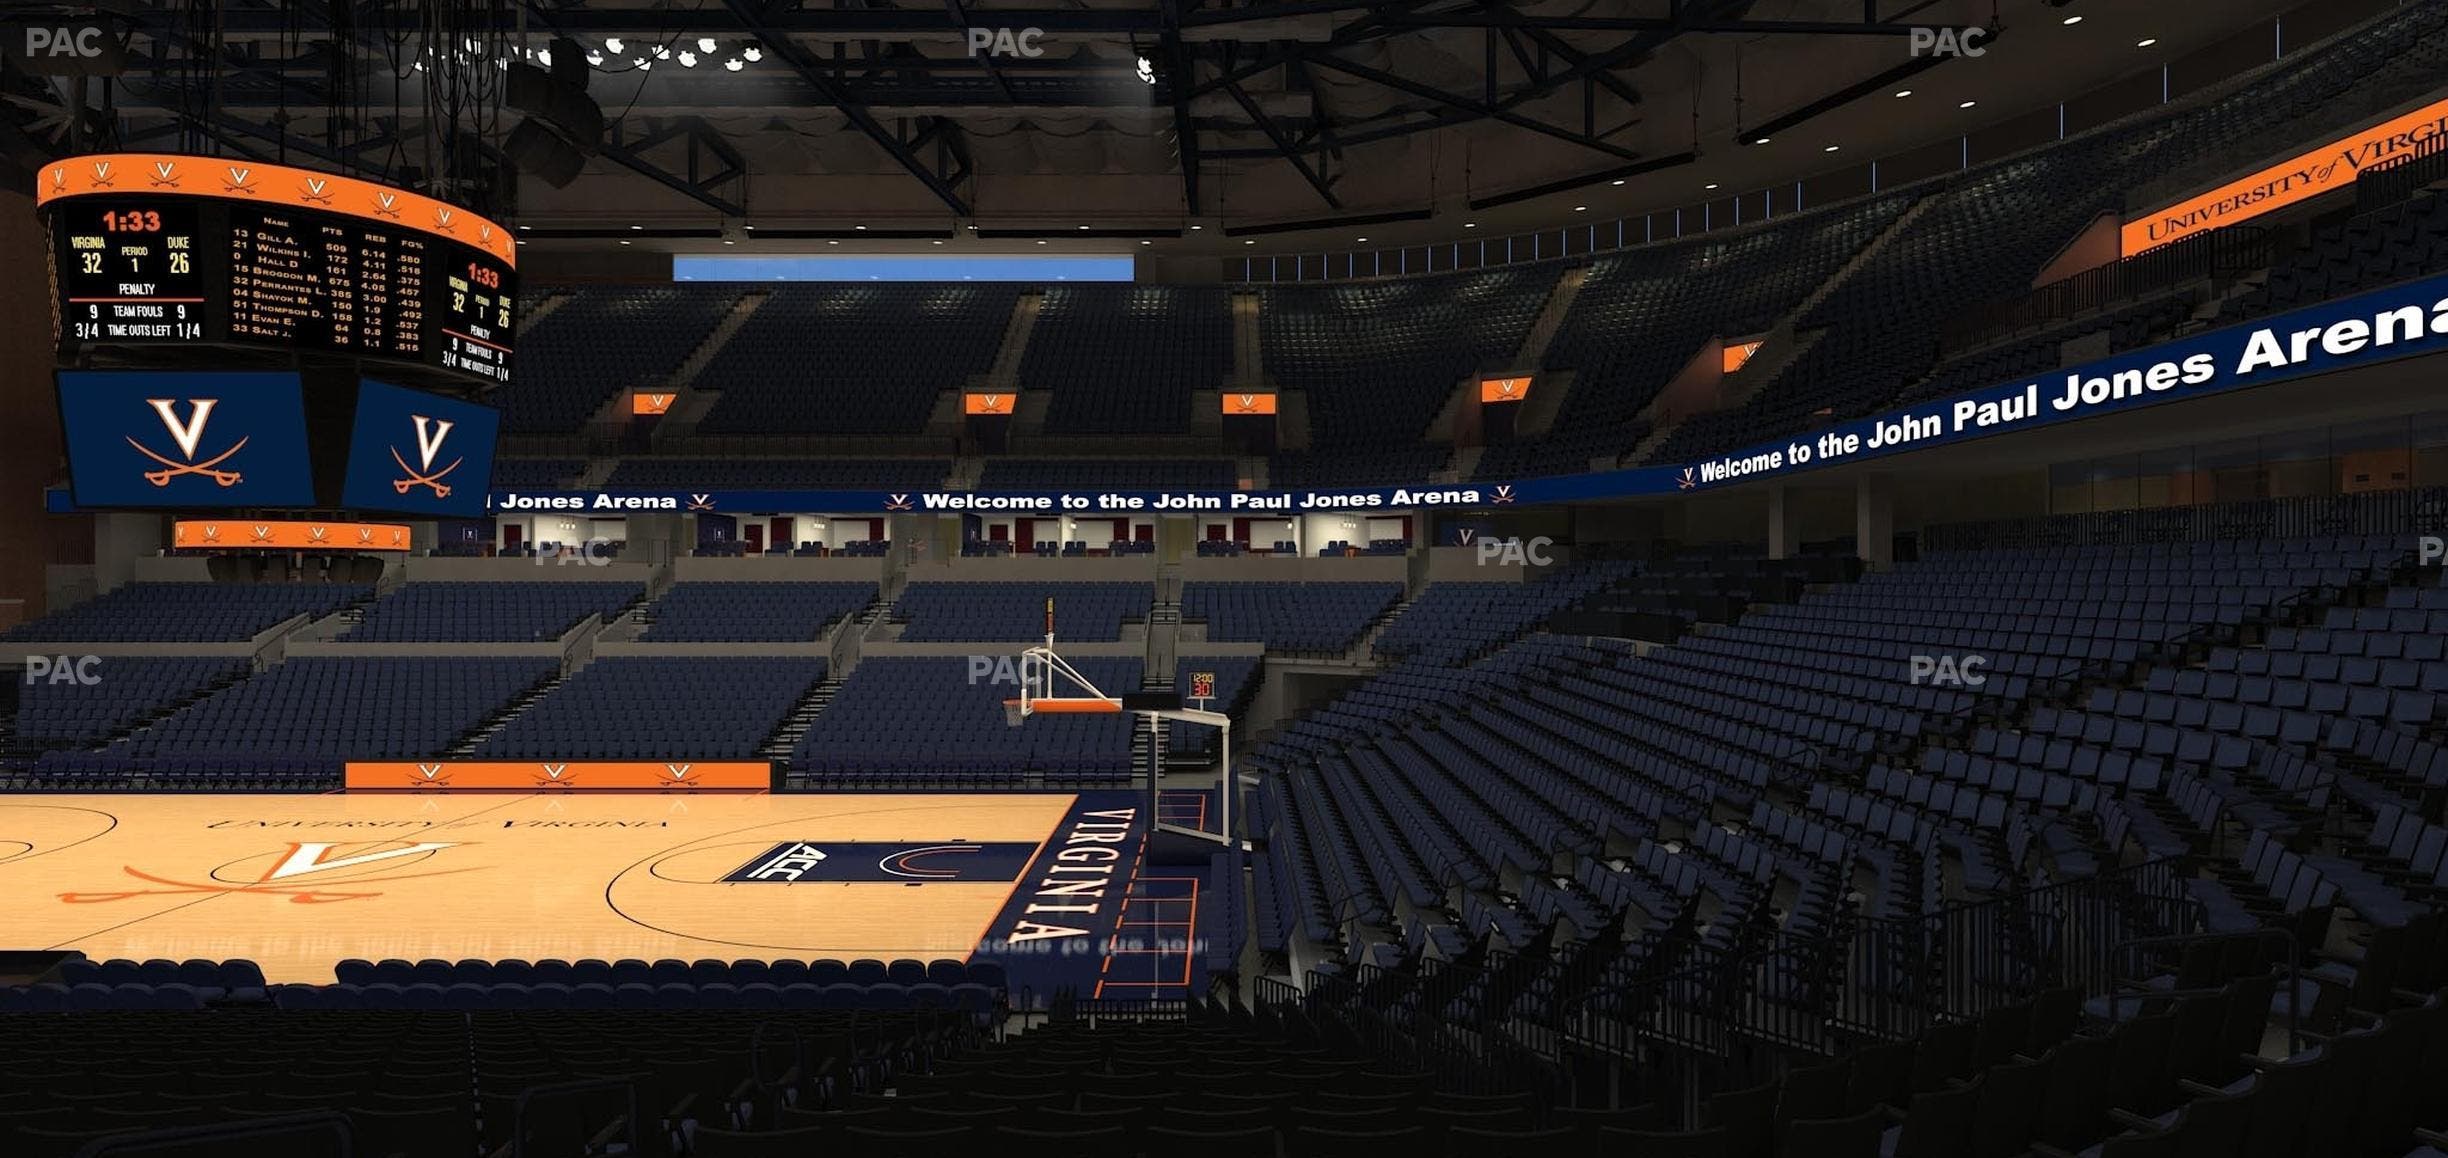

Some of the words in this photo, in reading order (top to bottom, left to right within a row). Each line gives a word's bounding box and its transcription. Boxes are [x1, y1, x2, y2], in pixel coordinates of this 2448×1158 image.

[2148, 166, 2319, 242] UNIVERSITY
[2317, 157, 2339, 183] of
[103, 211, 161, 232] 1:33
[71, 236, 106, 249] VIRGINIA
[167, 236, 190, 249] DUKE
[234, 229, 248, 237] 13
[285, 236, 299, 246] A.
[326, 243, 347, 253] 509
[362, 249, 386, 259] 6.14
[322, 227, 343, 236] PTS
[365, 234, 386, 243] REB
[402, 239, 423, 249] FG%
[81, 252, 103, 274] 32
[131, 258, 139, 273] 1
[169, 252, 190, 274] 26
[121, 246, 148, 256] PERIOD
[233, 240, 248, 249] 21
[303, 251, 311, 259] I.
[327, 255, 348, 264] 172
[363, 260, 386, 270] 4.11
[233, 252, 240, 260] 0
[290, 260, 298, 268] D
[326, 266, 346, 275] 161
[363, 271, 386, 280] 2.64
[397, 276, 420, 286] .375
[234, 264, 248, 273] 15
[307, 274, 321, 283] M.
[329, 278, 350, 287] 675
[468, 263, 498, 289] 1:33
[119, 283, 155, 295] PENALTY
[234, 277, 248, 286] 32
[315, 287, 327, 296] L.
[331, 290, 352, 299] 385
[363, 294, 386, 304] 3.00
[398, 300, 421, 308] .439
[89, 304, 98, 319] 9
[113, 305, 136, 317] TEAM
[137, 305, 163, 317] FOULS
[177, 304, 186, 319] 9
[233, 288, 248, 297] 04
[298, 297, 311, 305] M.
[332, 302, 352, 311] 150
[364, 306, 380, 314] 1.9
[399, 310, 422, 320] .492
[233, 301, 247, 309] 51
[312, 309, 324, 318] D.
[332, 313, 352, 322] 158
[364, 317, 381, 325] 1.2
[396, 321, 418, 330] .537
[453, 292, 464, 313] 32
[498, 309, 509, 328] 26
[107, 324, 127, 337] TIME
[129, 324, 150, 337] OUTS
[151, 324, 171, 337] LEFT
[233, 312, 246, 320] 11
[284, 318, 296, 326] E.
[335, 324, 348, 332] 64
[364, 328, 381, 336] 0.8
[396, 331, 419, 341] .383
[233, 324, 248, 332] 33
[335, 335, 348, 344] 36
[364, 339, 380, 348] 1.1
[453, 338, 458, 351] 9
[1700, 450, 1782, 483] Welcome
[1788, 442, 1811, 465] to
[1818, 433, 1859, 458] the
[1867, 415, 1941, 449] John
[1954, 384, 2037, 431] Paul
[2052, 352, 2215, 410] Jones
[500, 493, 584, 509] Jones
[593, 493, 677, 509] Arena
[922, 494, 1052, 509] Welcome
[1061, 495, 1089, 509] to
[1098, 494, 1144, 509] the
[1153, 494, 1220, 509] John
[1231, 493, 1290, 509] Paul
[1300, 492, 1382, 508] Jones
[1391, 489, 1479, 506] Arena
[1195, 682, 1210, 696] 30
[757, 844, 828, 882] ACC
[1007, 808, 1136, 944] VIRGINIA
